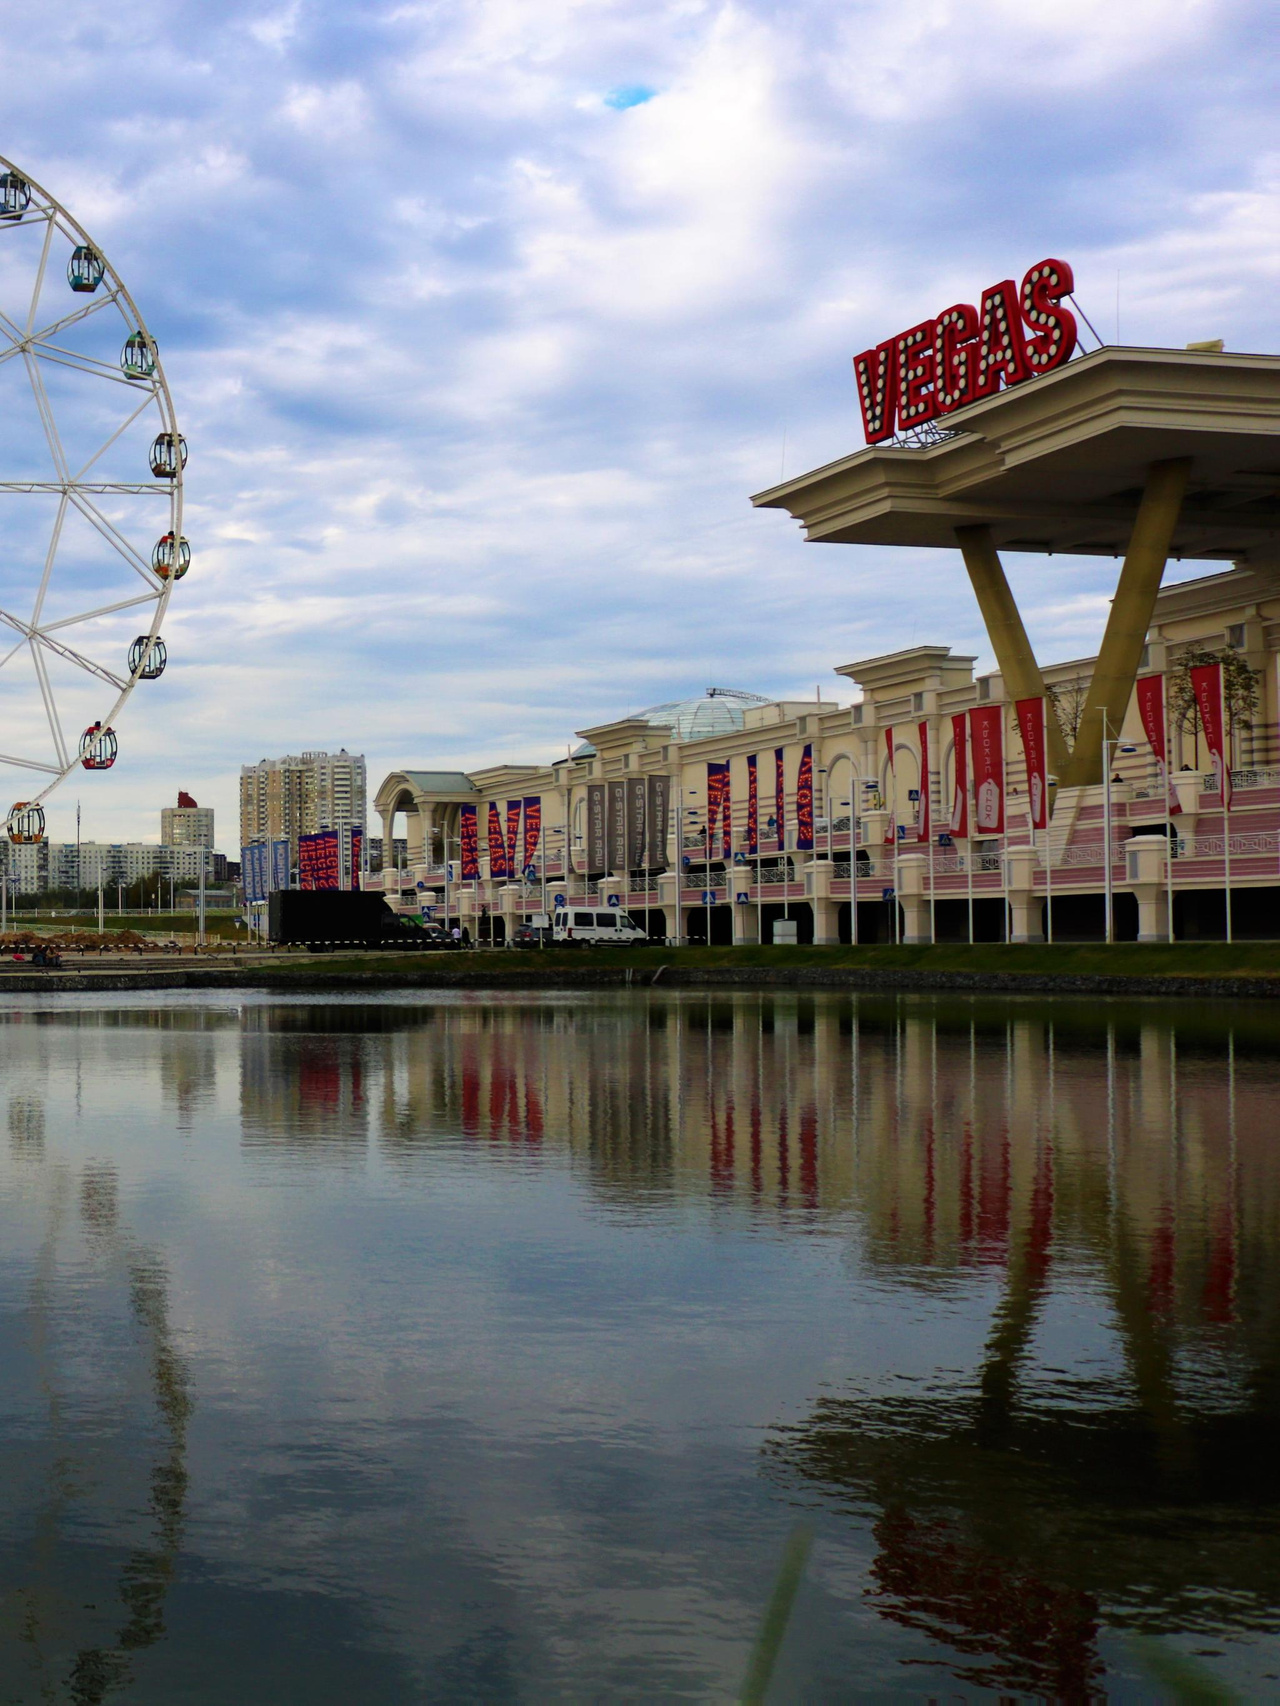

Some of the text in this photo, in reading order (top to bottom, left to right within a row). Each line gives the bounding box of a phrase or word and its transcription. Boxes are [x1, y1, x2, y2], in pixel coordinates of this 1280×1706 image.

[853, 258, 1077, 445] VEGAS
[489, 810, 506, 871] VEGAS
[596, 840, 604, 867] RAW
[616, 838, 624, 865] RAW
